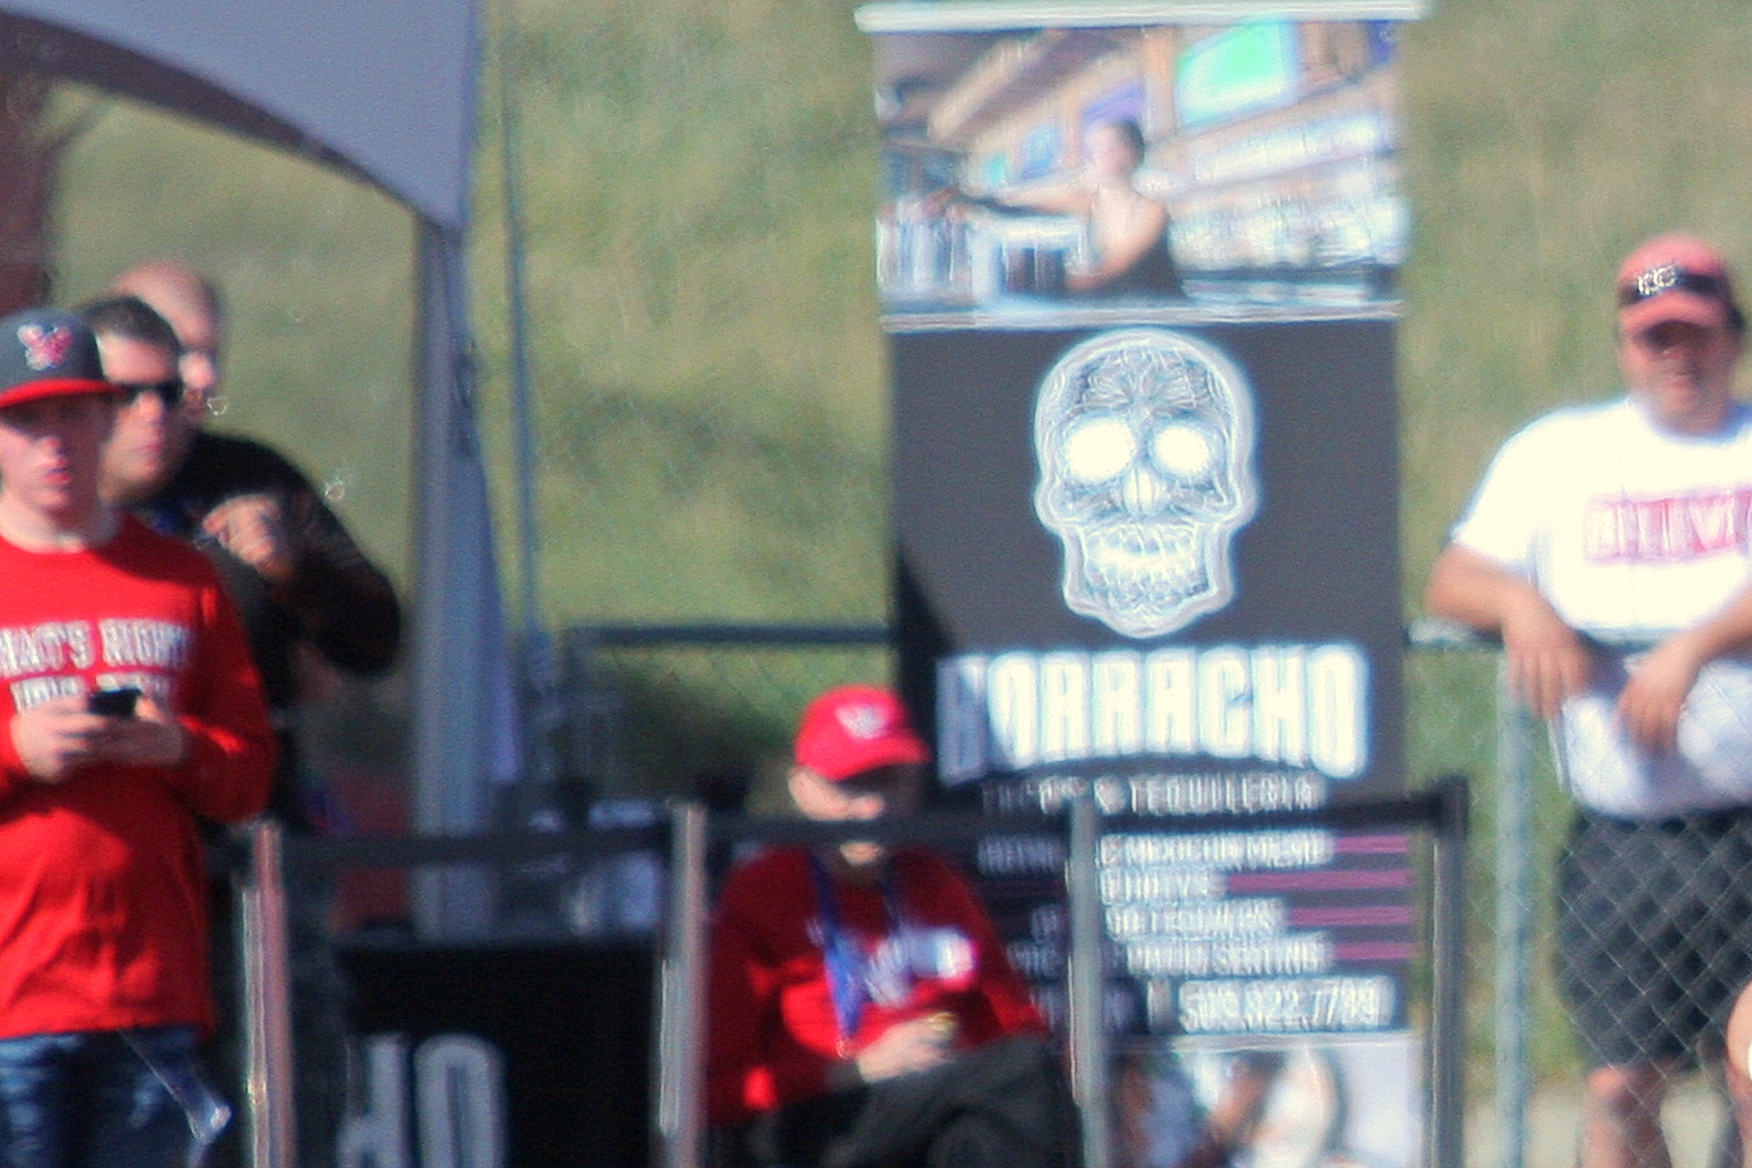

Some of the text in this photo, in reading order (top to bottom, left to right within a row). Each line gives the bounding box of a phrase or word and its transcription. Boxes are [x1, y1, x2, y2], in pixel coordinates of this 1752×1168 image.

[0, 619, 95, 676] HAT'S
[937, 643, 1370, 787] BORRACHO
[1129, 769, 1327, 816] TEQUILERIA
